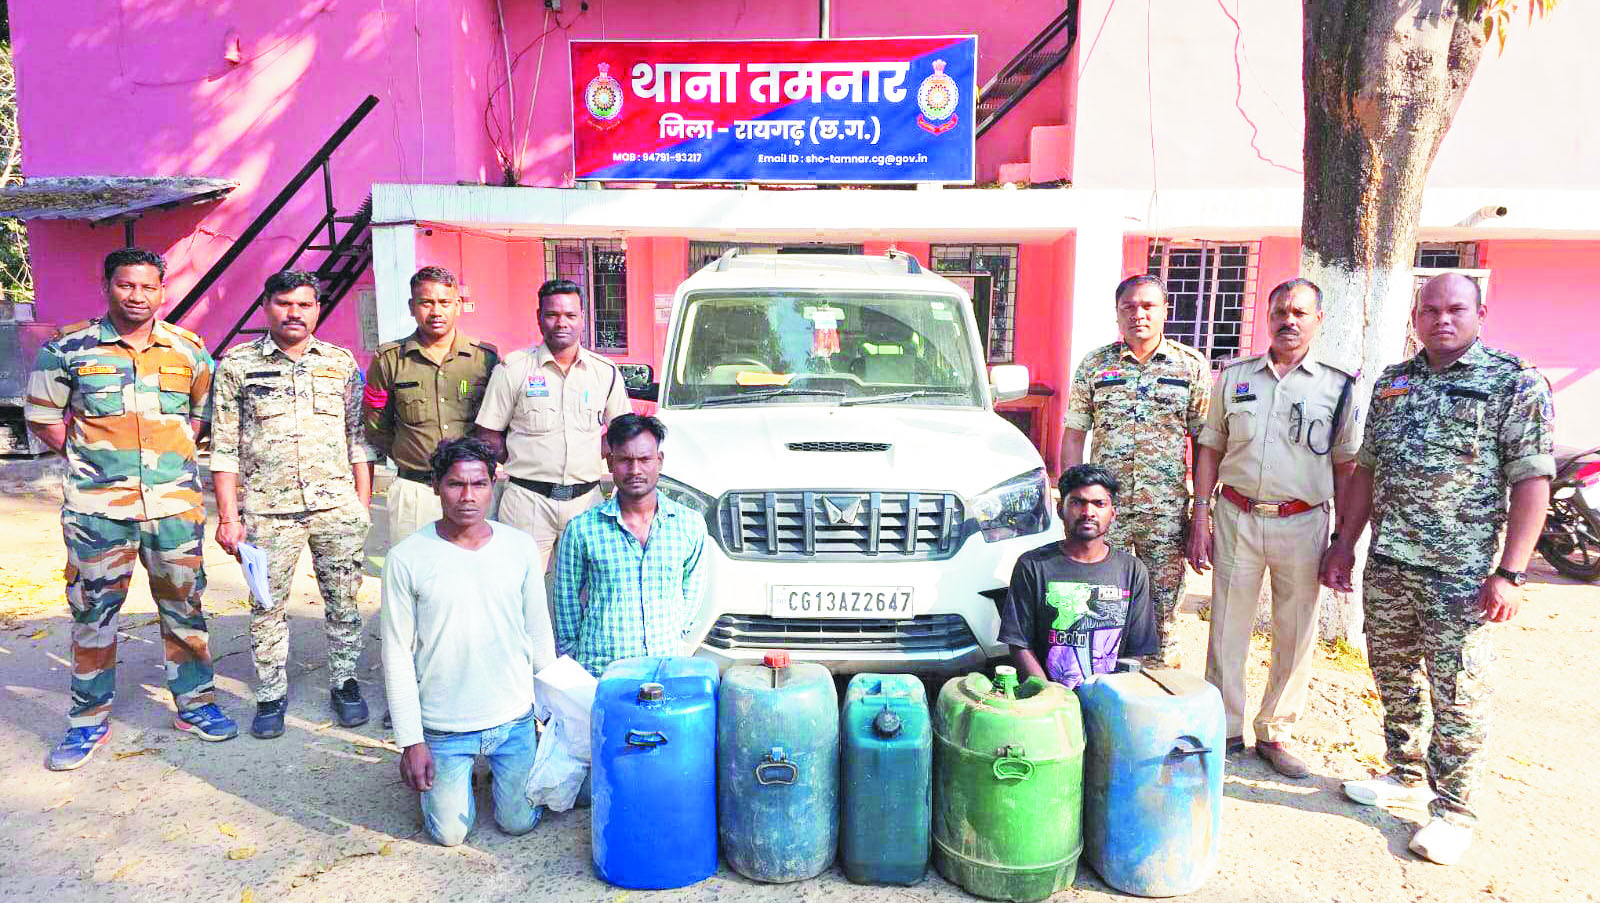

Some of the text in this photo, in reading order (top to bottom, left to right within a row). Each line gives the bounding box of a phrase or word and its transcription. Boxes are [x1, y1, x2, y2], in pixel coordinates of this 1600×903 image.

[631, 61, 910, 103] थाना तमनार
[659, 113, 714, 139] जिला
[734, 120, 805, 146] रायगढ़
[809, 116, 881, 145] (छ.ग.)
[642, 152, 702, 163] 94791-93217
[758, 154, 787, 164] Email
[788, 154, 799, 164] ID
[805, 153, 928, 166] sho-tamnar.cg@gov.in
[788, 591, 911, 612] CG13AZ2647
